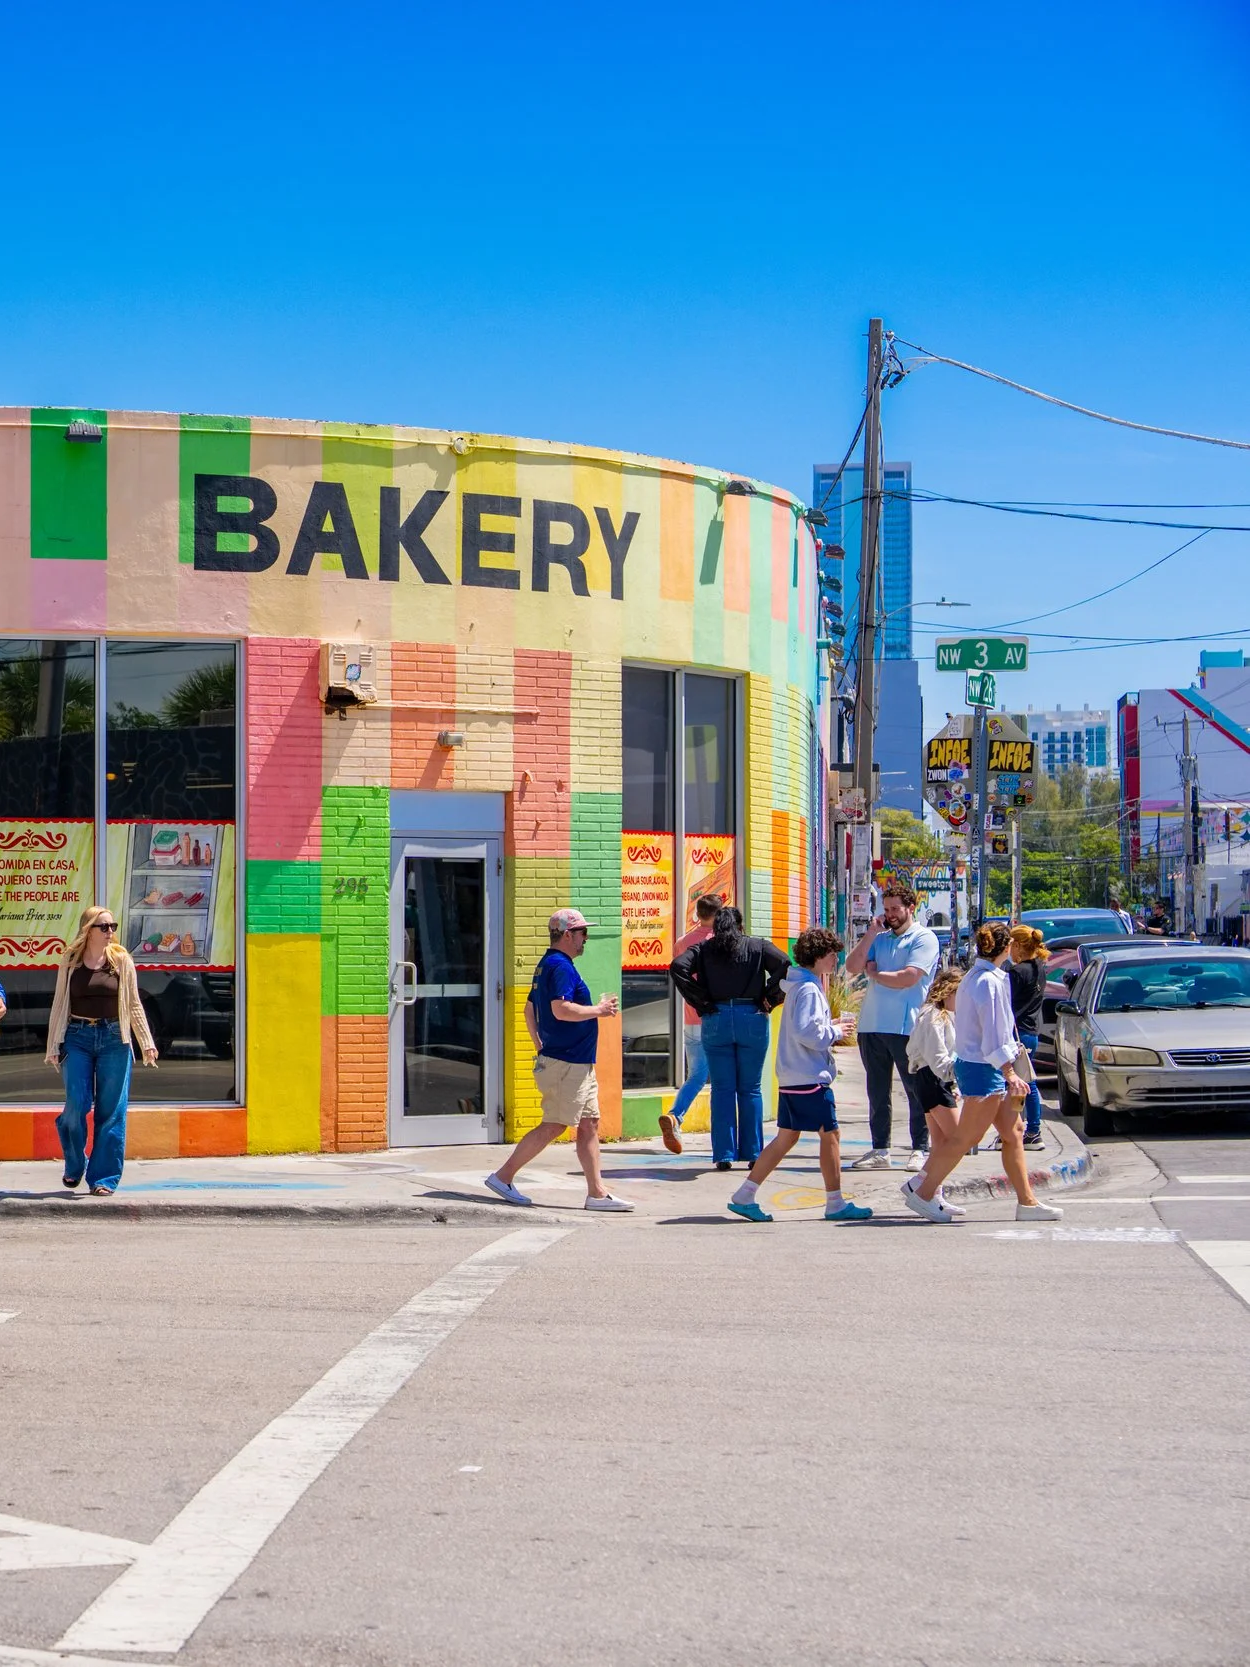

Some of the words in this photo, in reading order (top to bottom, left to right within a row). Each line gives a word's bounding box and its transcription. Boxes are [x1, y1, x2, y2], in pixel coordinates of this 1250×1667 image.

[193, 474, 640, 600] BAKERY
[939, 649, 961, 665] NW
[974, 641, 988, 667] 3
[1004, 648, 1023, 664] AV
[969, 680, 981, 697] NW
[983, 675, 993, 703] 26
[989, 741, 1032, 771] INFOE
[33, 859, 46, 870] EN
[49, 859, 79, 872] CASA,
[36, 875, 67, 885] ESTAR
[334, 876, 368, 894] 295
[622, 876, 640, 885] ARANJA
[918, 880, 962, 890] sweetgren
[4, 891, 22, 901] THE
[24, 891, 58, 901] PEOPLE
[61, 891, 80, 901] ARE
[622, 892, 642, 902] REGANO,
[622, 908, 634, 917] ASTE
[634, 908, 645, 917] LIKE
[647, 908, 660, 917] HOME
